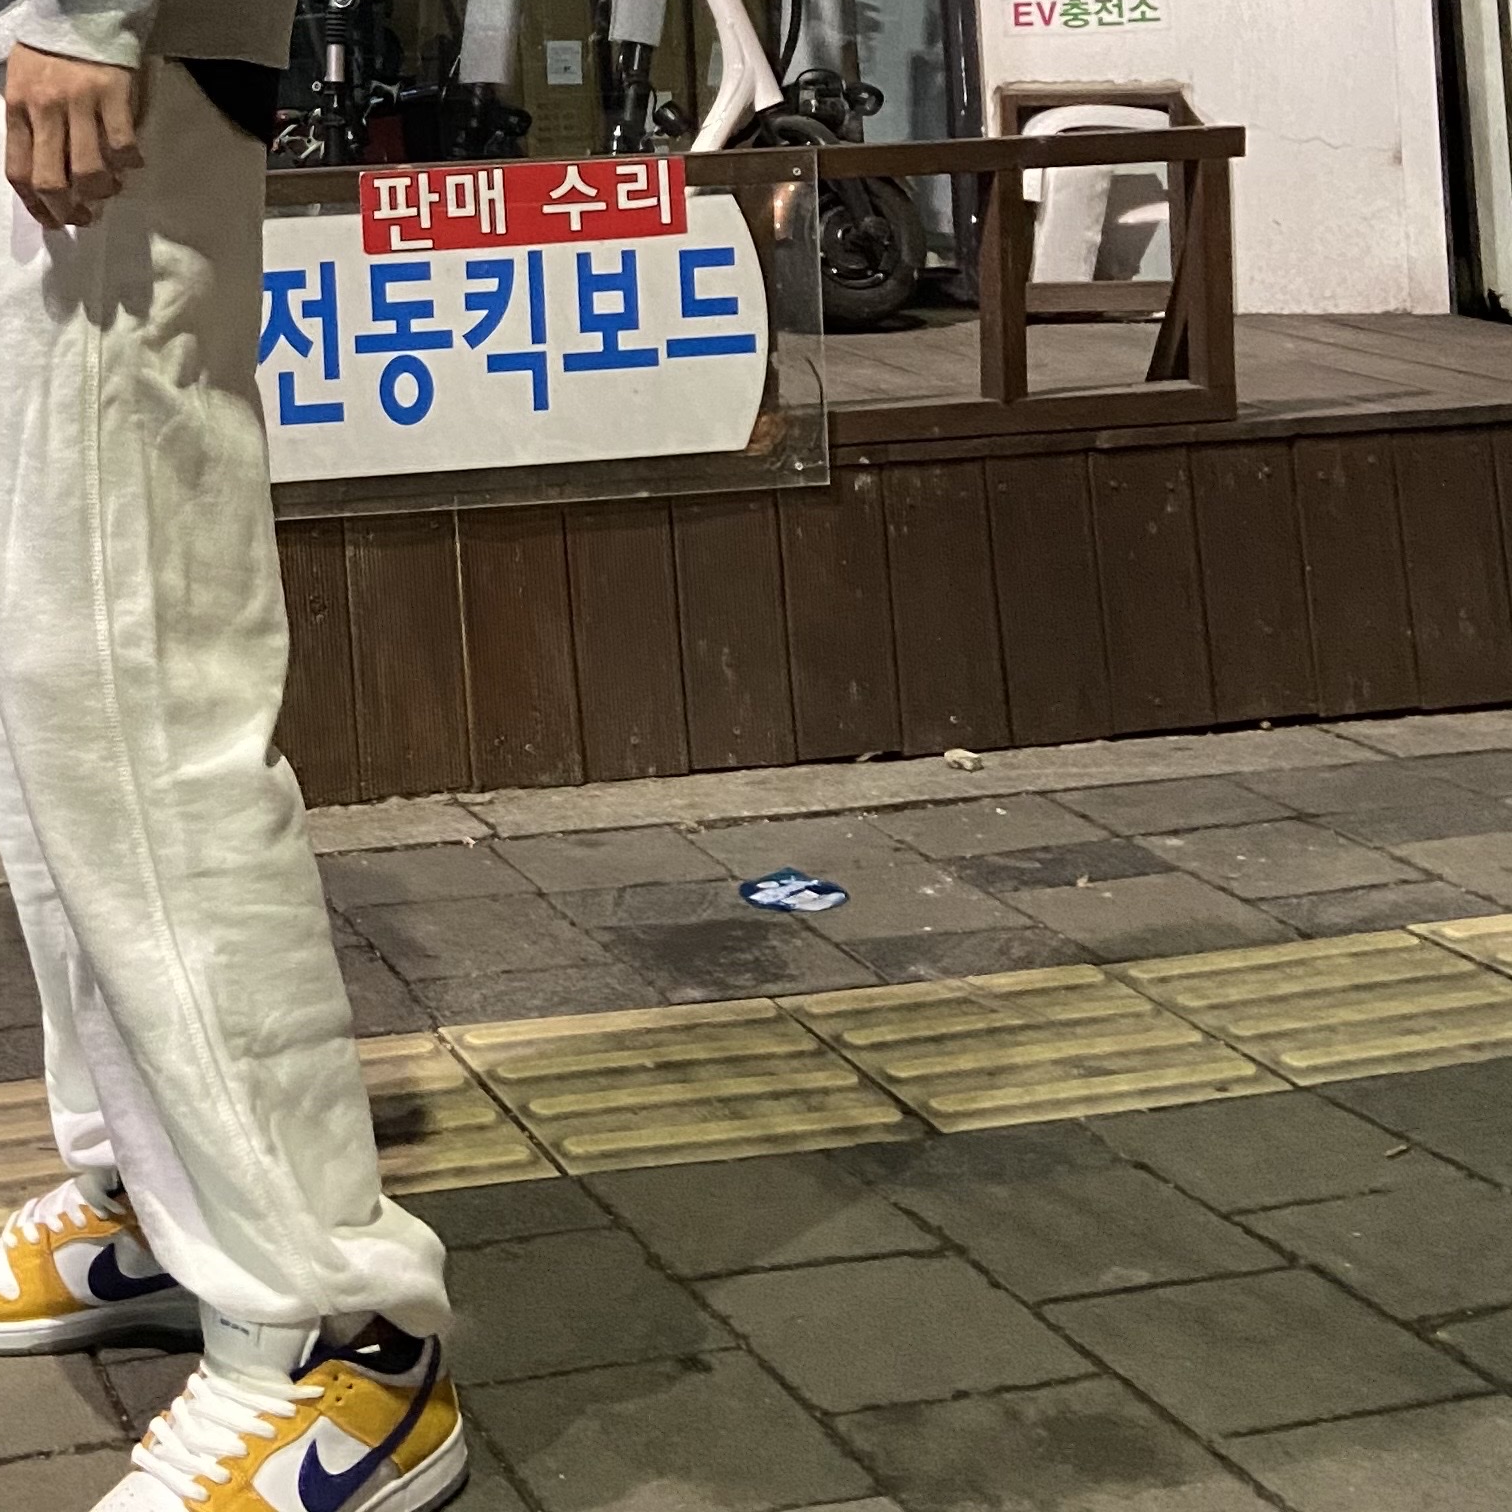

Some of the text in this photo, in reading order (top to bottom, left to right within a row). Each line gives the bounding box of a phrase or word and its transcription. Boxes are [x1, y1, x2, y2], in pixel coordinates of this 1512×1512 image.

[372, 158, 673, 251] 판매 수리
[258, 246, 757, 426] 전동킥보드
